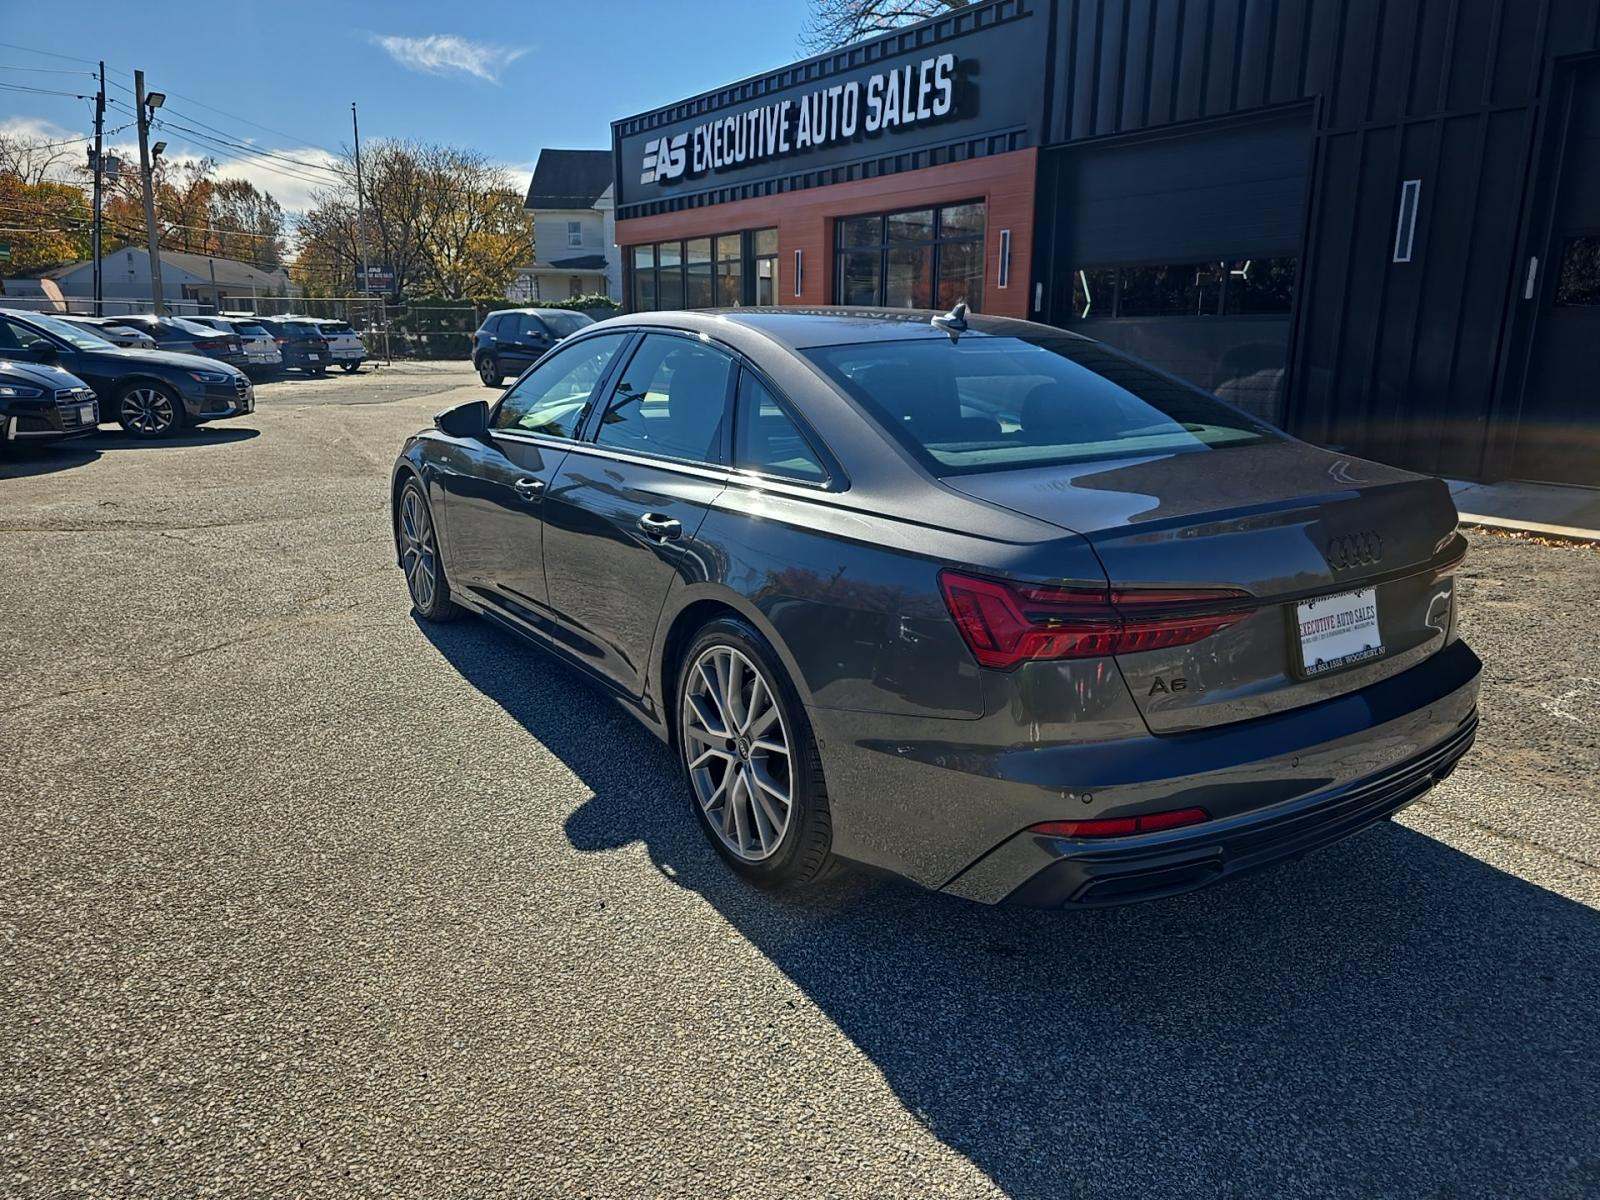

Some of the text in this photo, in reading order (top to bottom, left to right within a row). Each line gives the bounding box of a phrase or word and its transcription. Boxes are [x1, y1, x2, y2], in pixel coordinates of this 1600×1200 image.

[693, 100, 791, 172] EXECUTIVE
[796, 81, 859, 149] AUTO
[866, 53, 955, 132] SALES
[1336, 610, 1354, 628] AUTO
[1354, 605, 1375, 623] SALES
[1148, 676, 1188, 696] A6
